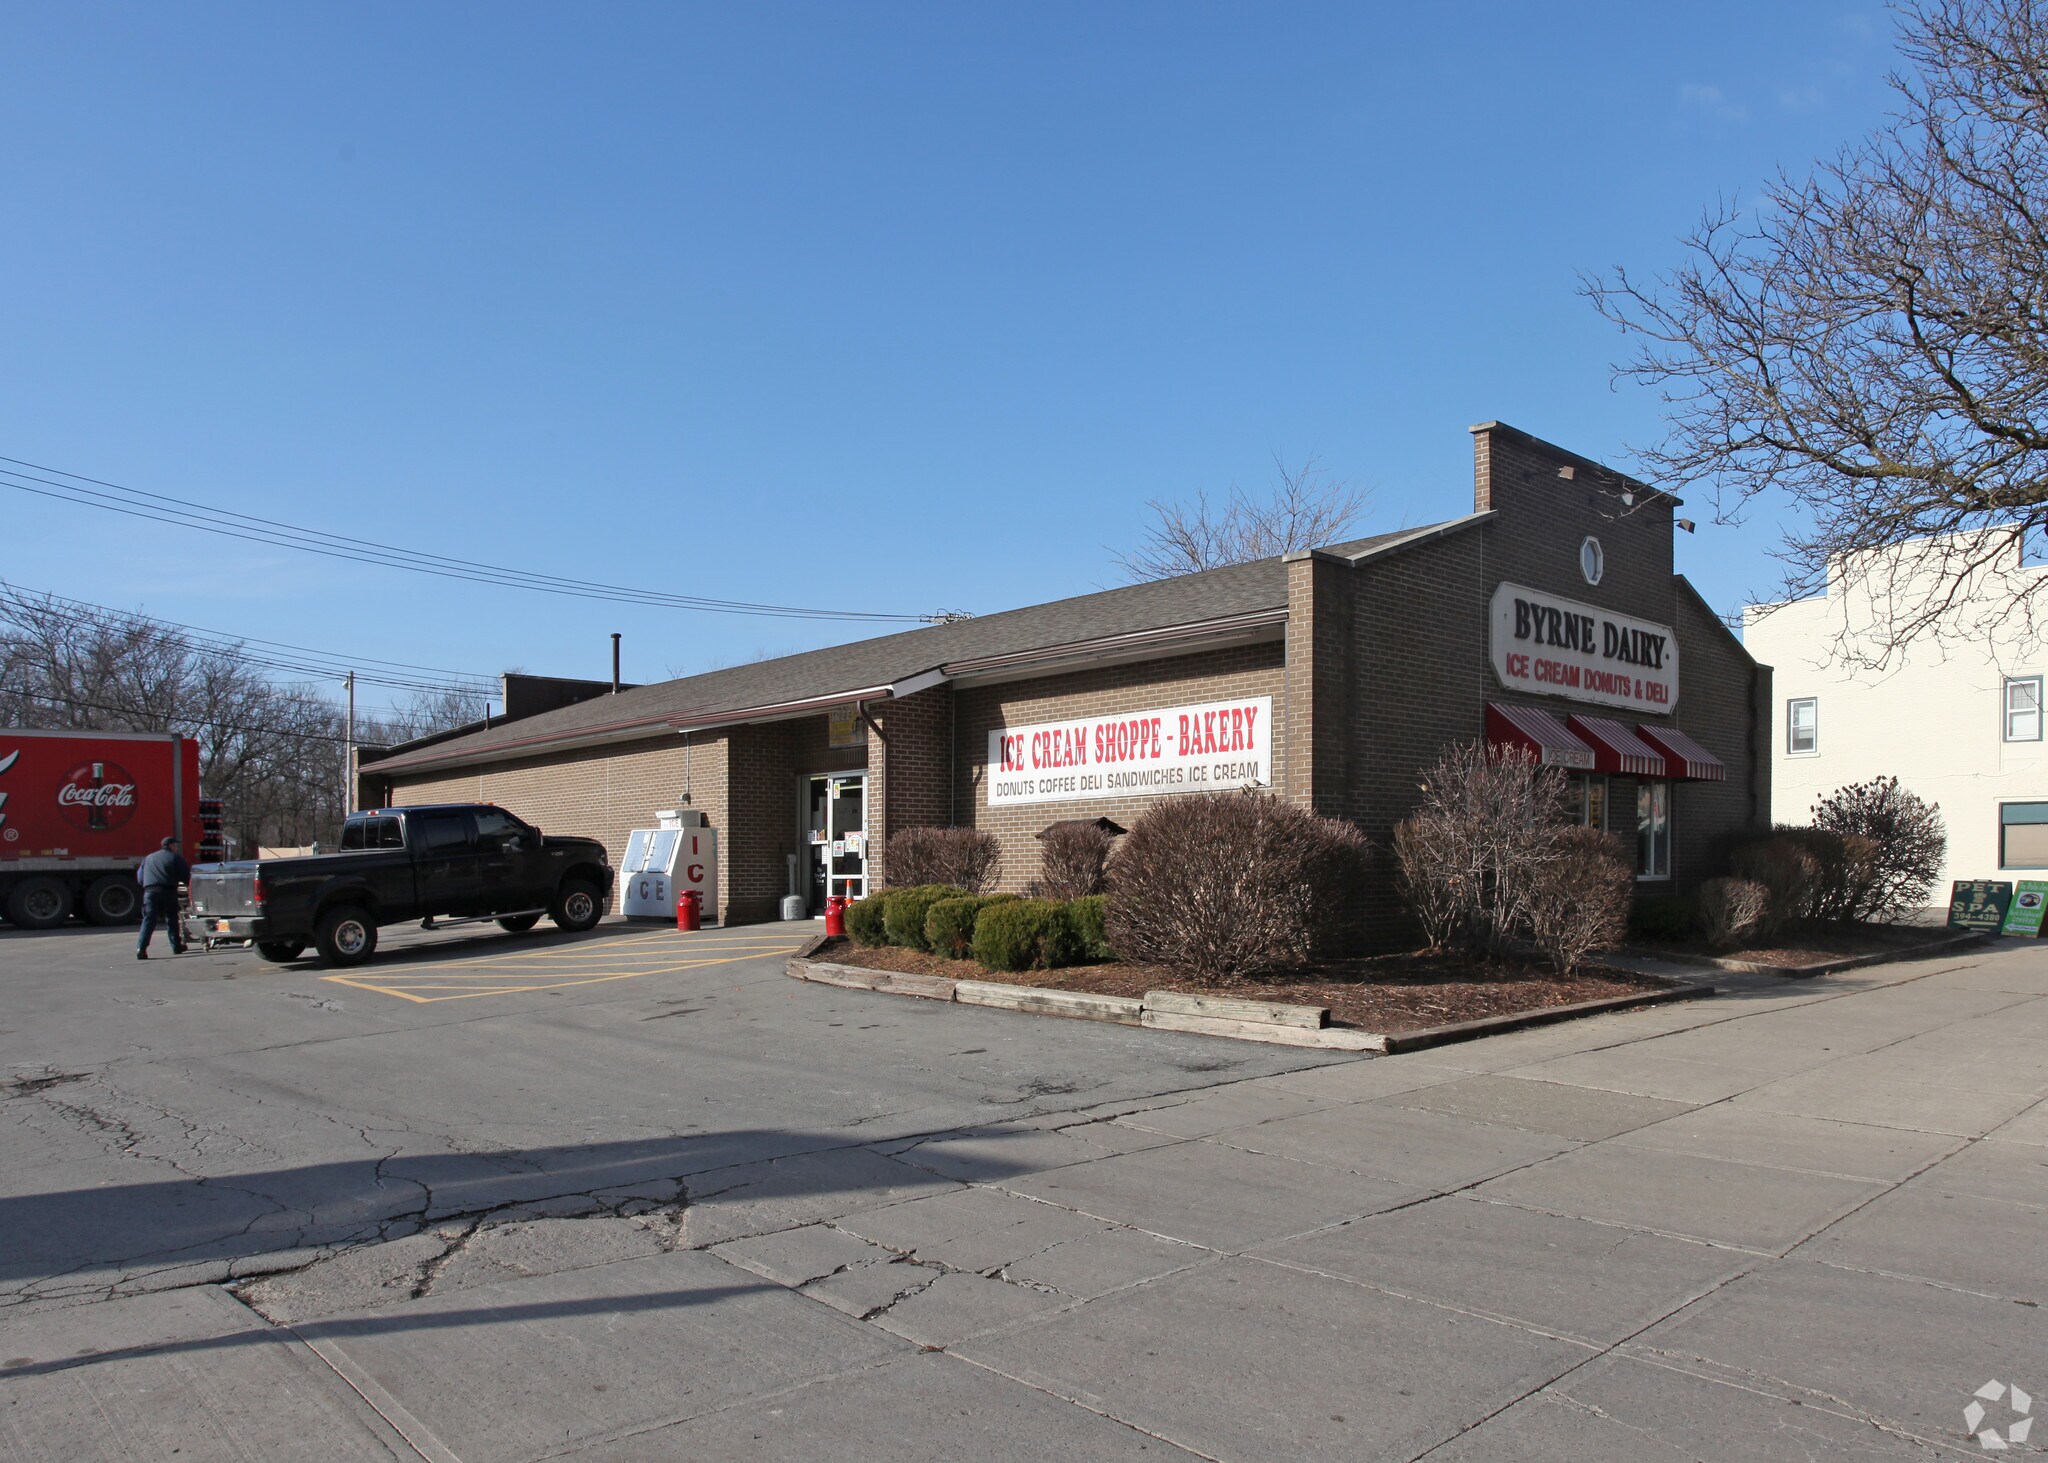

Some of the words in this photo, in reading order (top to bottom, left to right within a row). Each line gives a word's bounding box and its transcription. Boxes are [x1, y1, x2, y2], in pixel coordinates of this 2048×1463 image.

[1514, 598, 1596, 654] BYRNE
[1603, 621, 1666, 669] DAIRY
[1506, 652, 1530, 679] ICE
[1534, 658, 1580, 689] CREAM
[1584, 668, 1631, 697] DONUTS
[1634, 679, 1643, 700] &
[1646, 680, 1669, 704] DELI
[999, 734, 1025, 773] ICE
[1032, 726, 1087, 769] CREAM
[1095, 717, 1161, 764] SHOPPE
[1178, 705, 1258, 756] BAKERY
[1564, 751, 1590, 766] CREAM
[996, 779, 1035, 797] DONUTS
[1039, 775, 1076, 793] COFFEE
[1080, 774, 1103, 791] DELI
[1107, 767, 1183, 789] SANDWICHES
[1189, 765, 1207, 783] ICE
[1213, 761, 1259, 781] CREAM
[58, 783, 135, 806] Coca-Cola
[627, 880, 664, 901] ICE
[1956, 882, 2004, 893] PET
[1952, 901, 1999, 913] SPA
[1953, 912, 2000, 921] 394-4380
